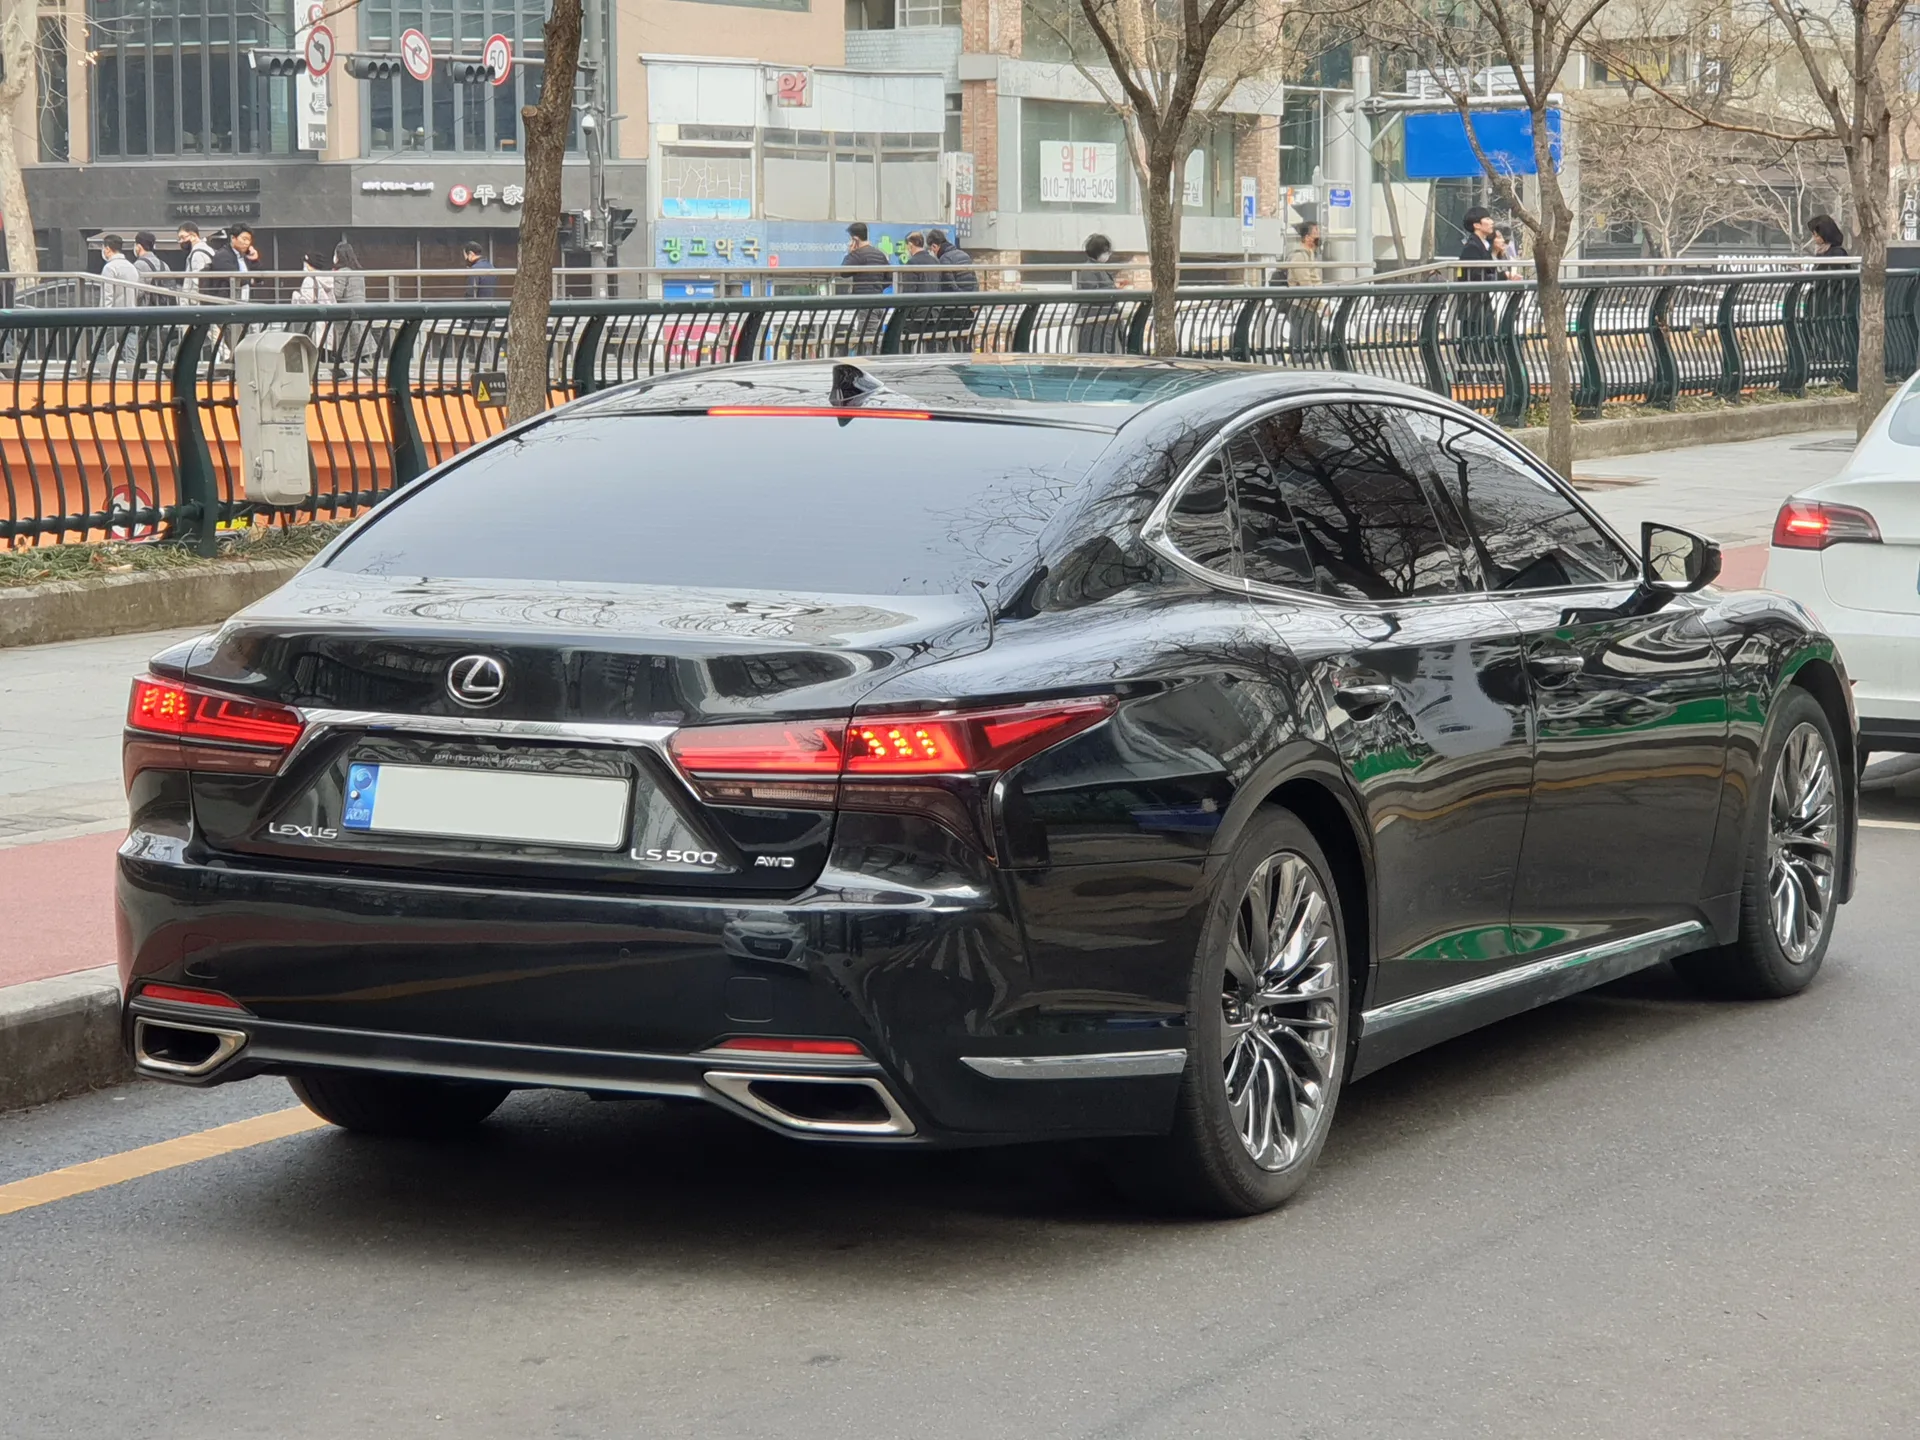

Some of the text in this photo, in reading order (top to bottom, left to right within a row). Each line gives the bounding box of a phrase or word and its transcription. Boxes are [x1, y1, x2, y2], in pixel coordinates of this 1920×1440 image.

[490, 50, 504, 70] 50
[778, 71, 807, 106] 약
[1061, 145, 1097, 173] 임대
[473, 184, 525, 206] 平家
[1042, 176, 1115, 199] 010-7403-5429
[663, 237, 761, 263] 광교약국
[268, 822, 338, 839] LEXUS
[630, 848, 718, 865] LS 500
[754, 855, 795, 868] AWD
